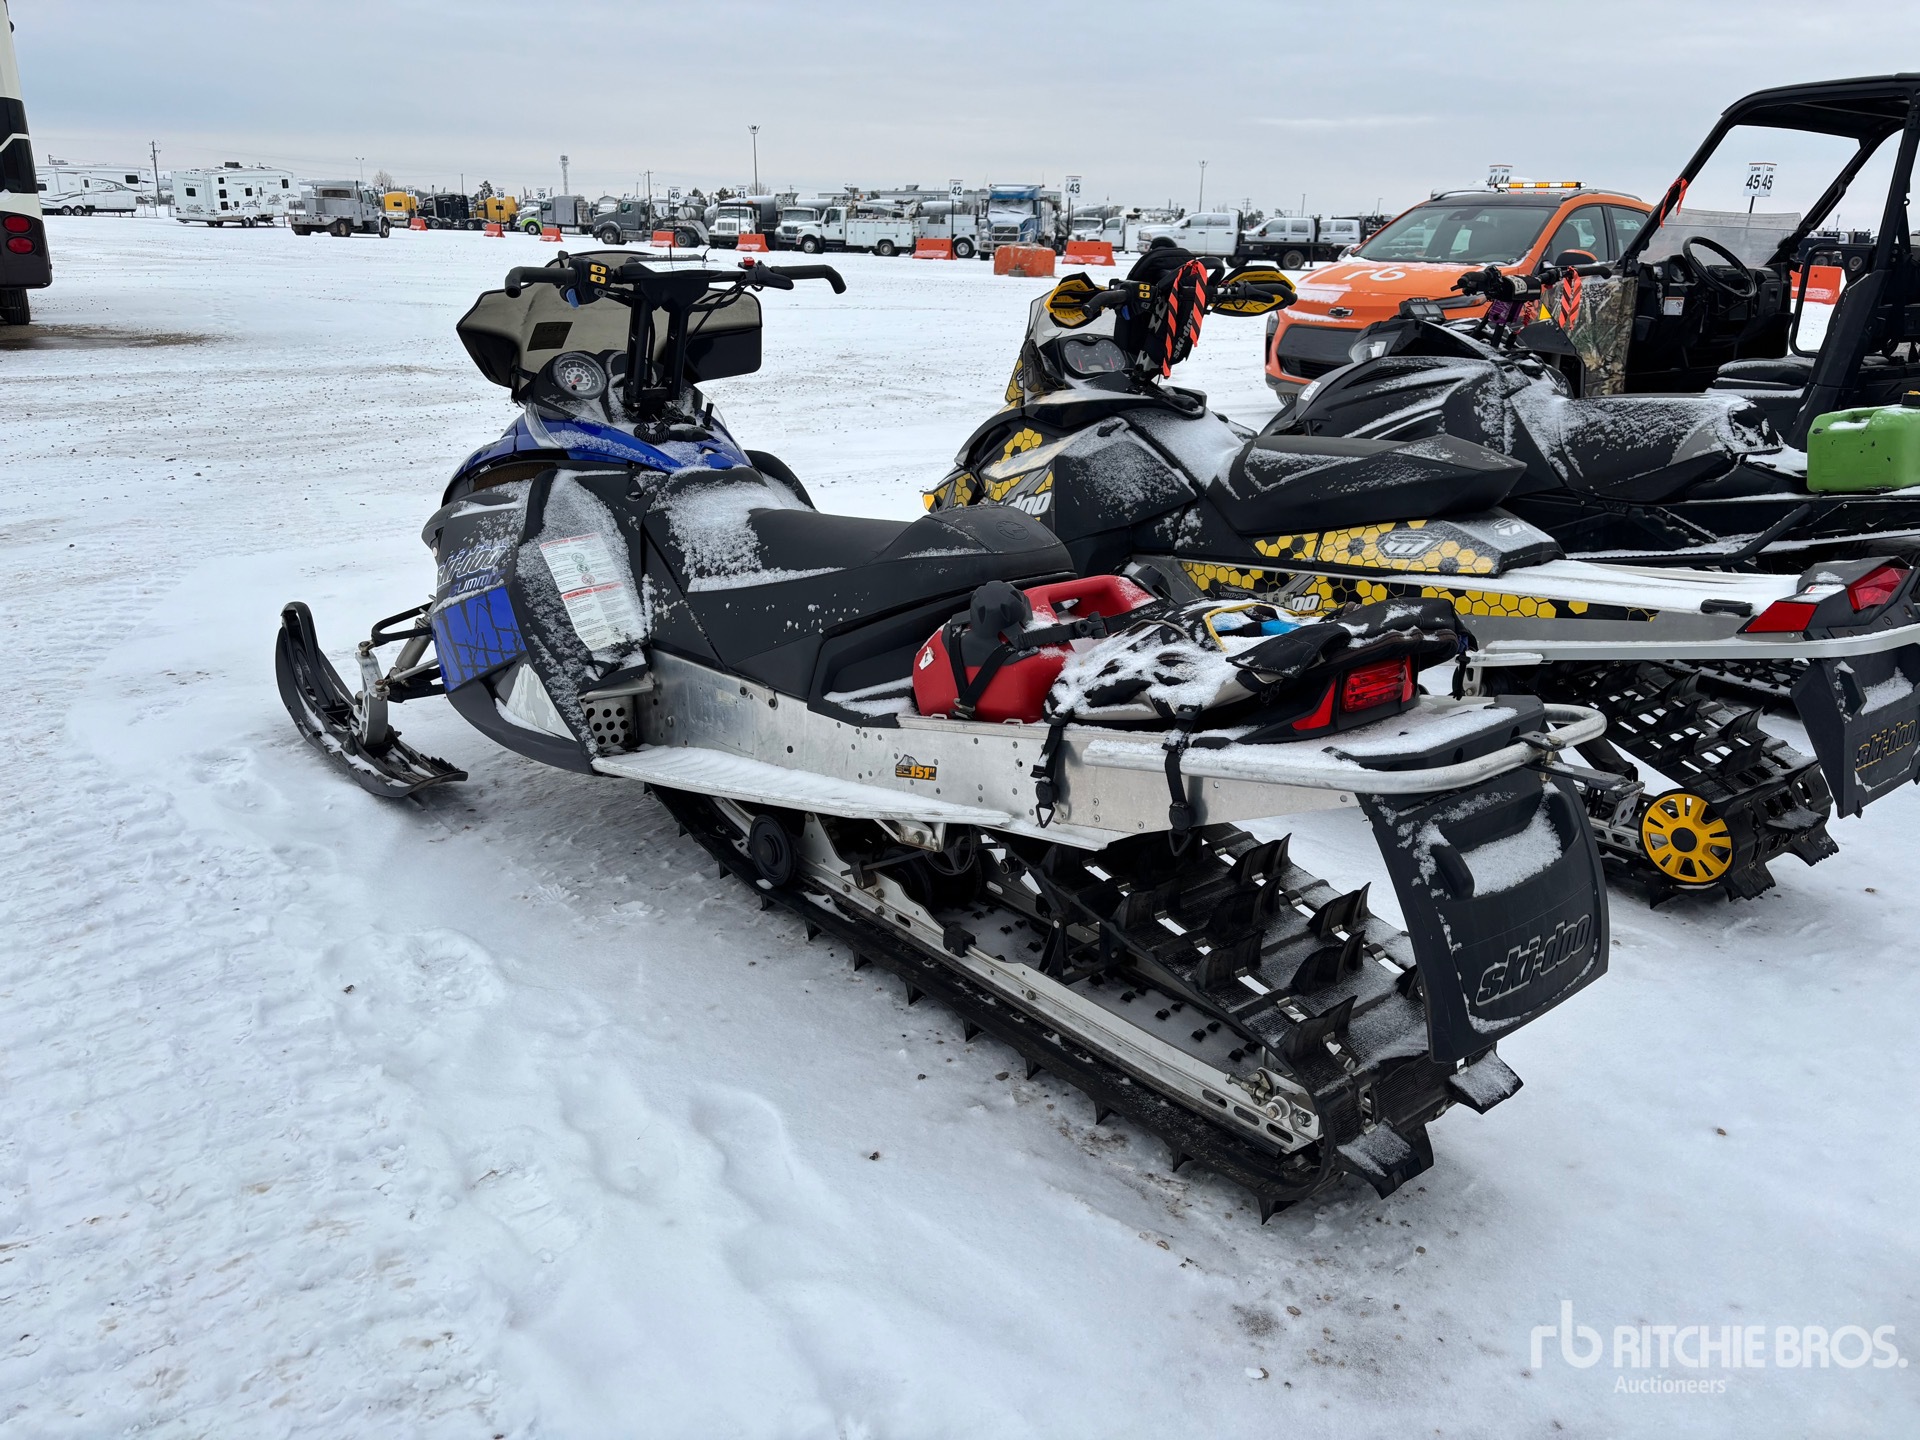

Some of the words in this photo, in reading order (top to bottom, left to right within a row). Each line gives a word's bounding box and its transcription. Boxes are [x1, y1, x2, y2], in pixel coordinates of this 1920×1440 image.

[1070, 183, 1080, 194] 43
[1746, 174, 1761, 190] 45
[1762, 174, 1774, 190] 45
[670, 192, 680, 200] 40
[737, 190, 746, 198] 41
[952, 186, 962, 196] 42
[1854, 719, 1917, 771] ski-doo
[1476, 913, 1592, 1006] ski-doo
